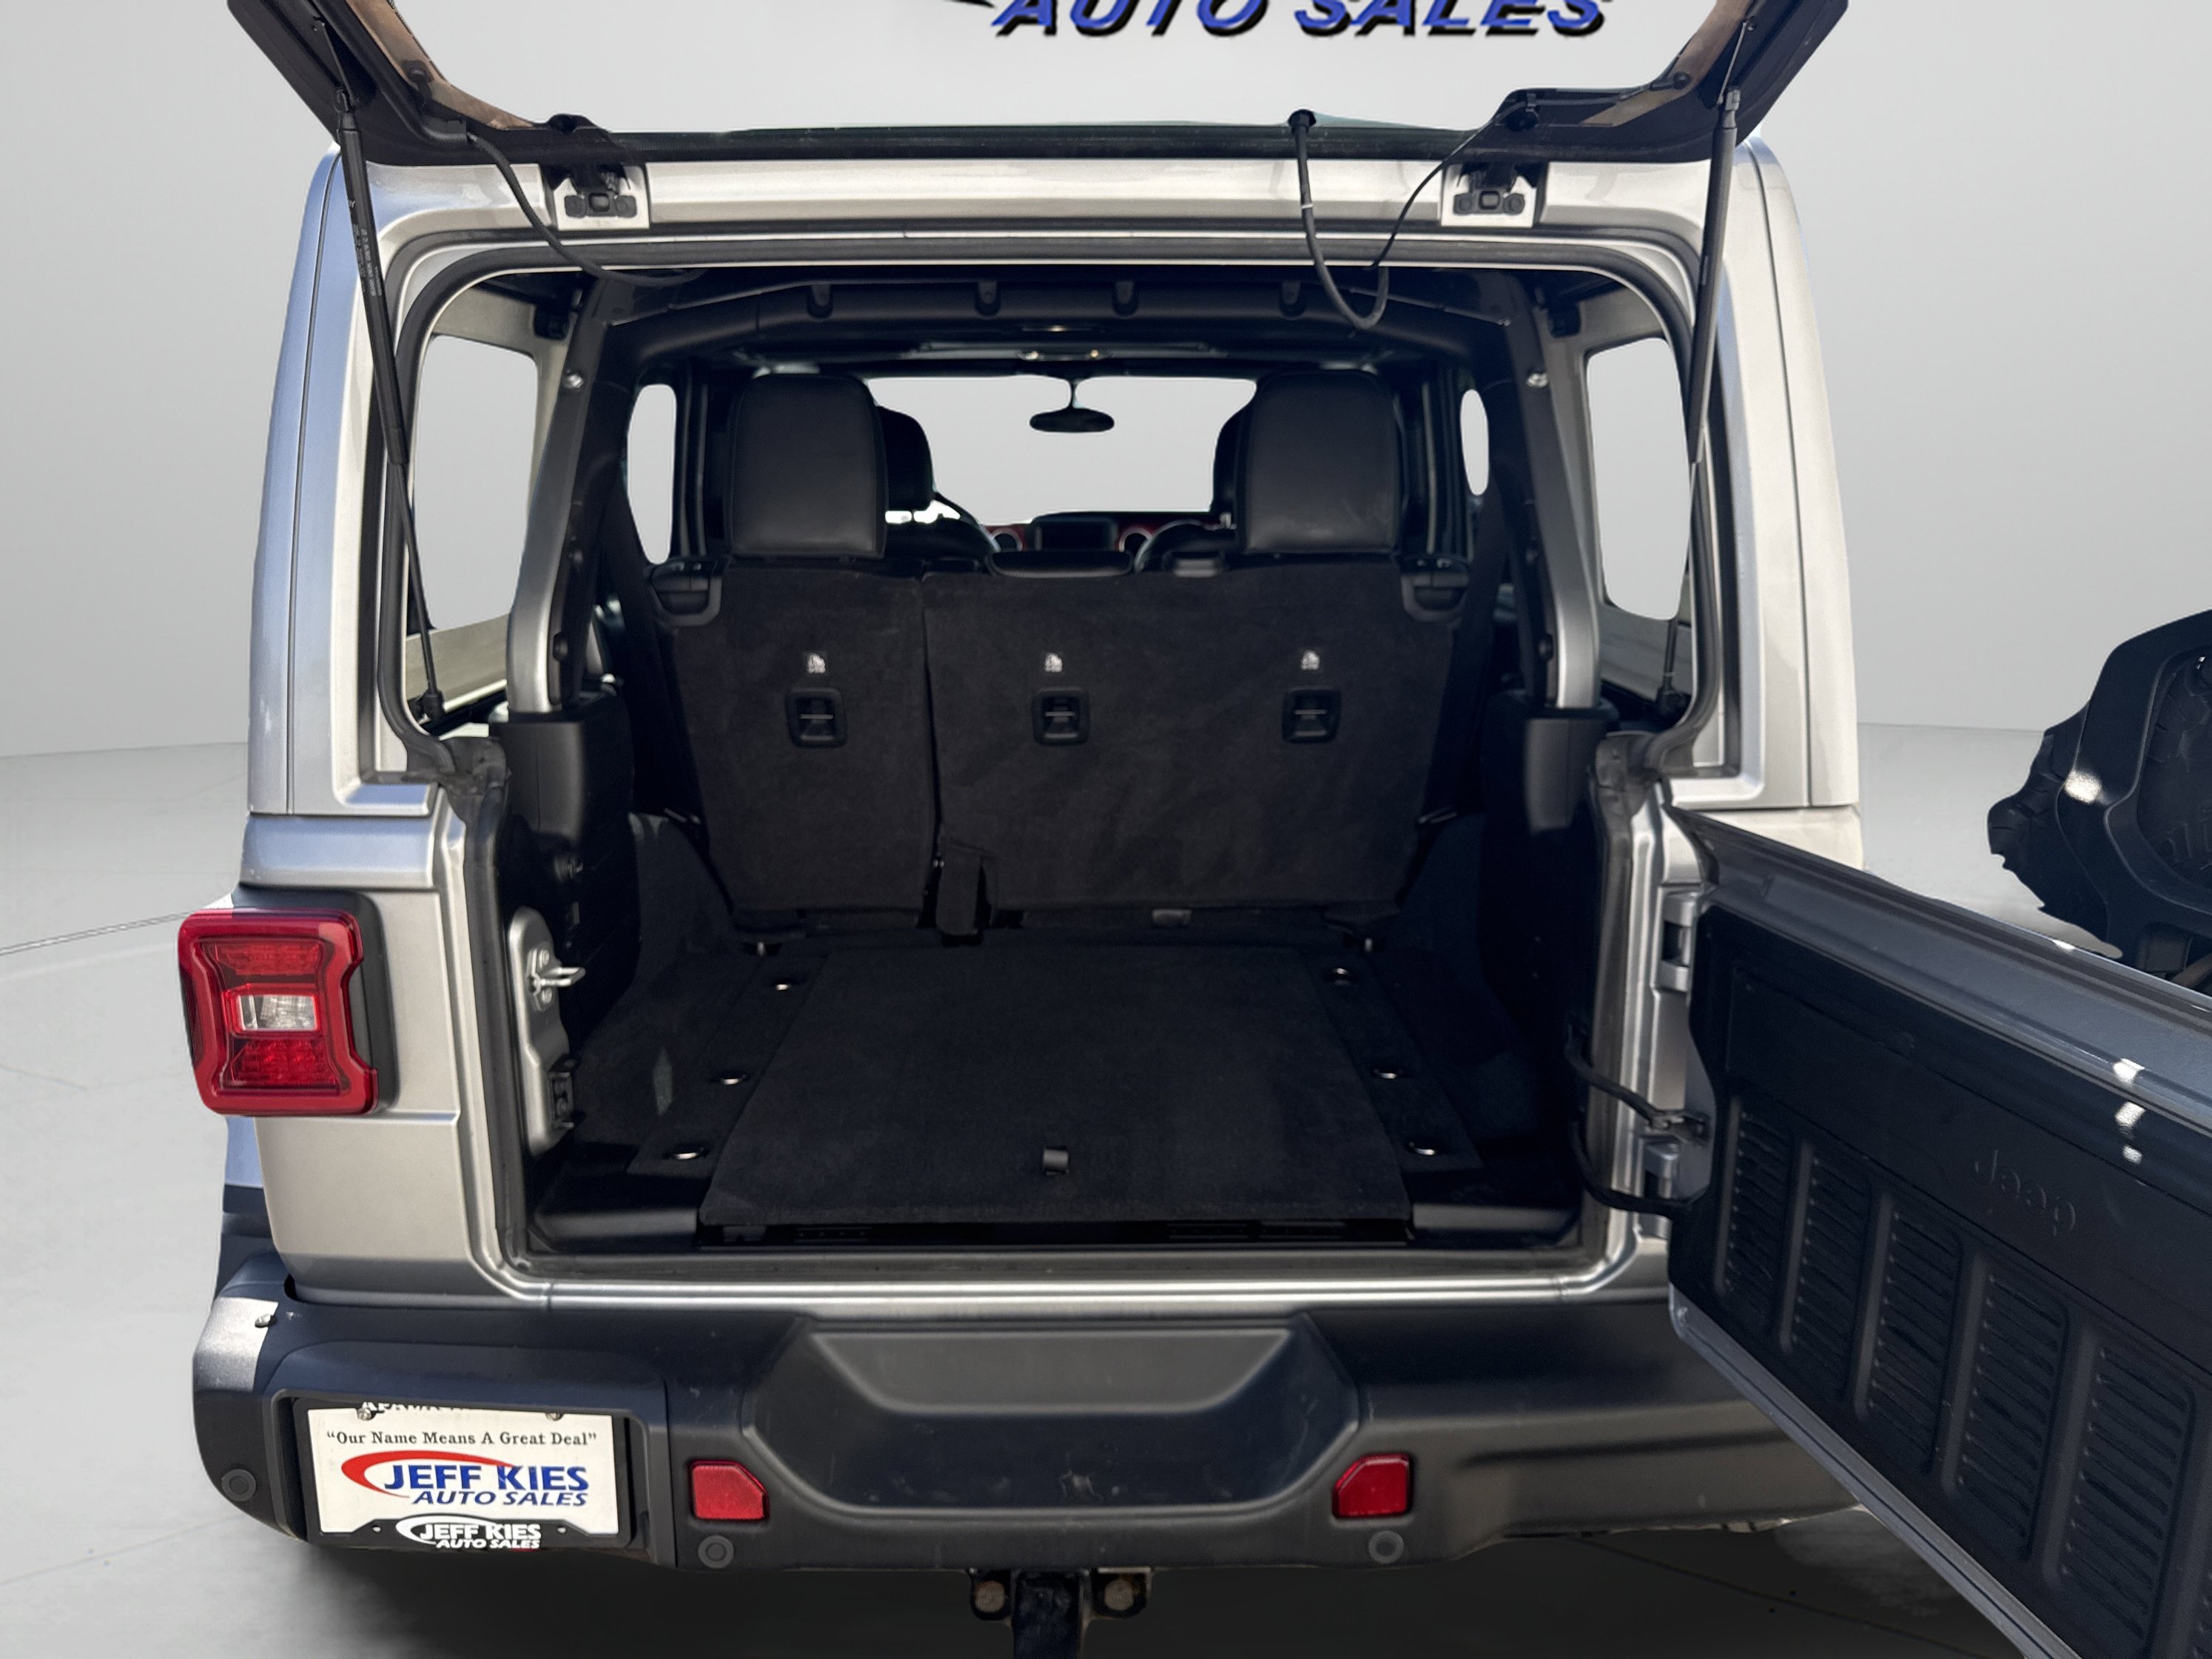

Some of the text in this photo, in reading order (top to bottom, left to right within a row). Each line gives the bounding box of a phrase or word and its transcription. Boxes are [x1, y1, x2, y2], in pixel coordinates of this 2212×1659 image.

[1973, 1148, 2077, 1239] Jeep
[372, 1430, 417, 1444] Name
[423, 1431, 476, 1445] Means
[481, 1431, 494, 1444] A
[500, 1431, 545, 1445] Great
[384, 1464, 590, 1492] JEFF KIES
[411, 1490, 589, 1507] AUTO SALES
[420, 1524, 542, 1541] JEFF KIES
[436, 1538, 541, 1549] AUTO SALES
